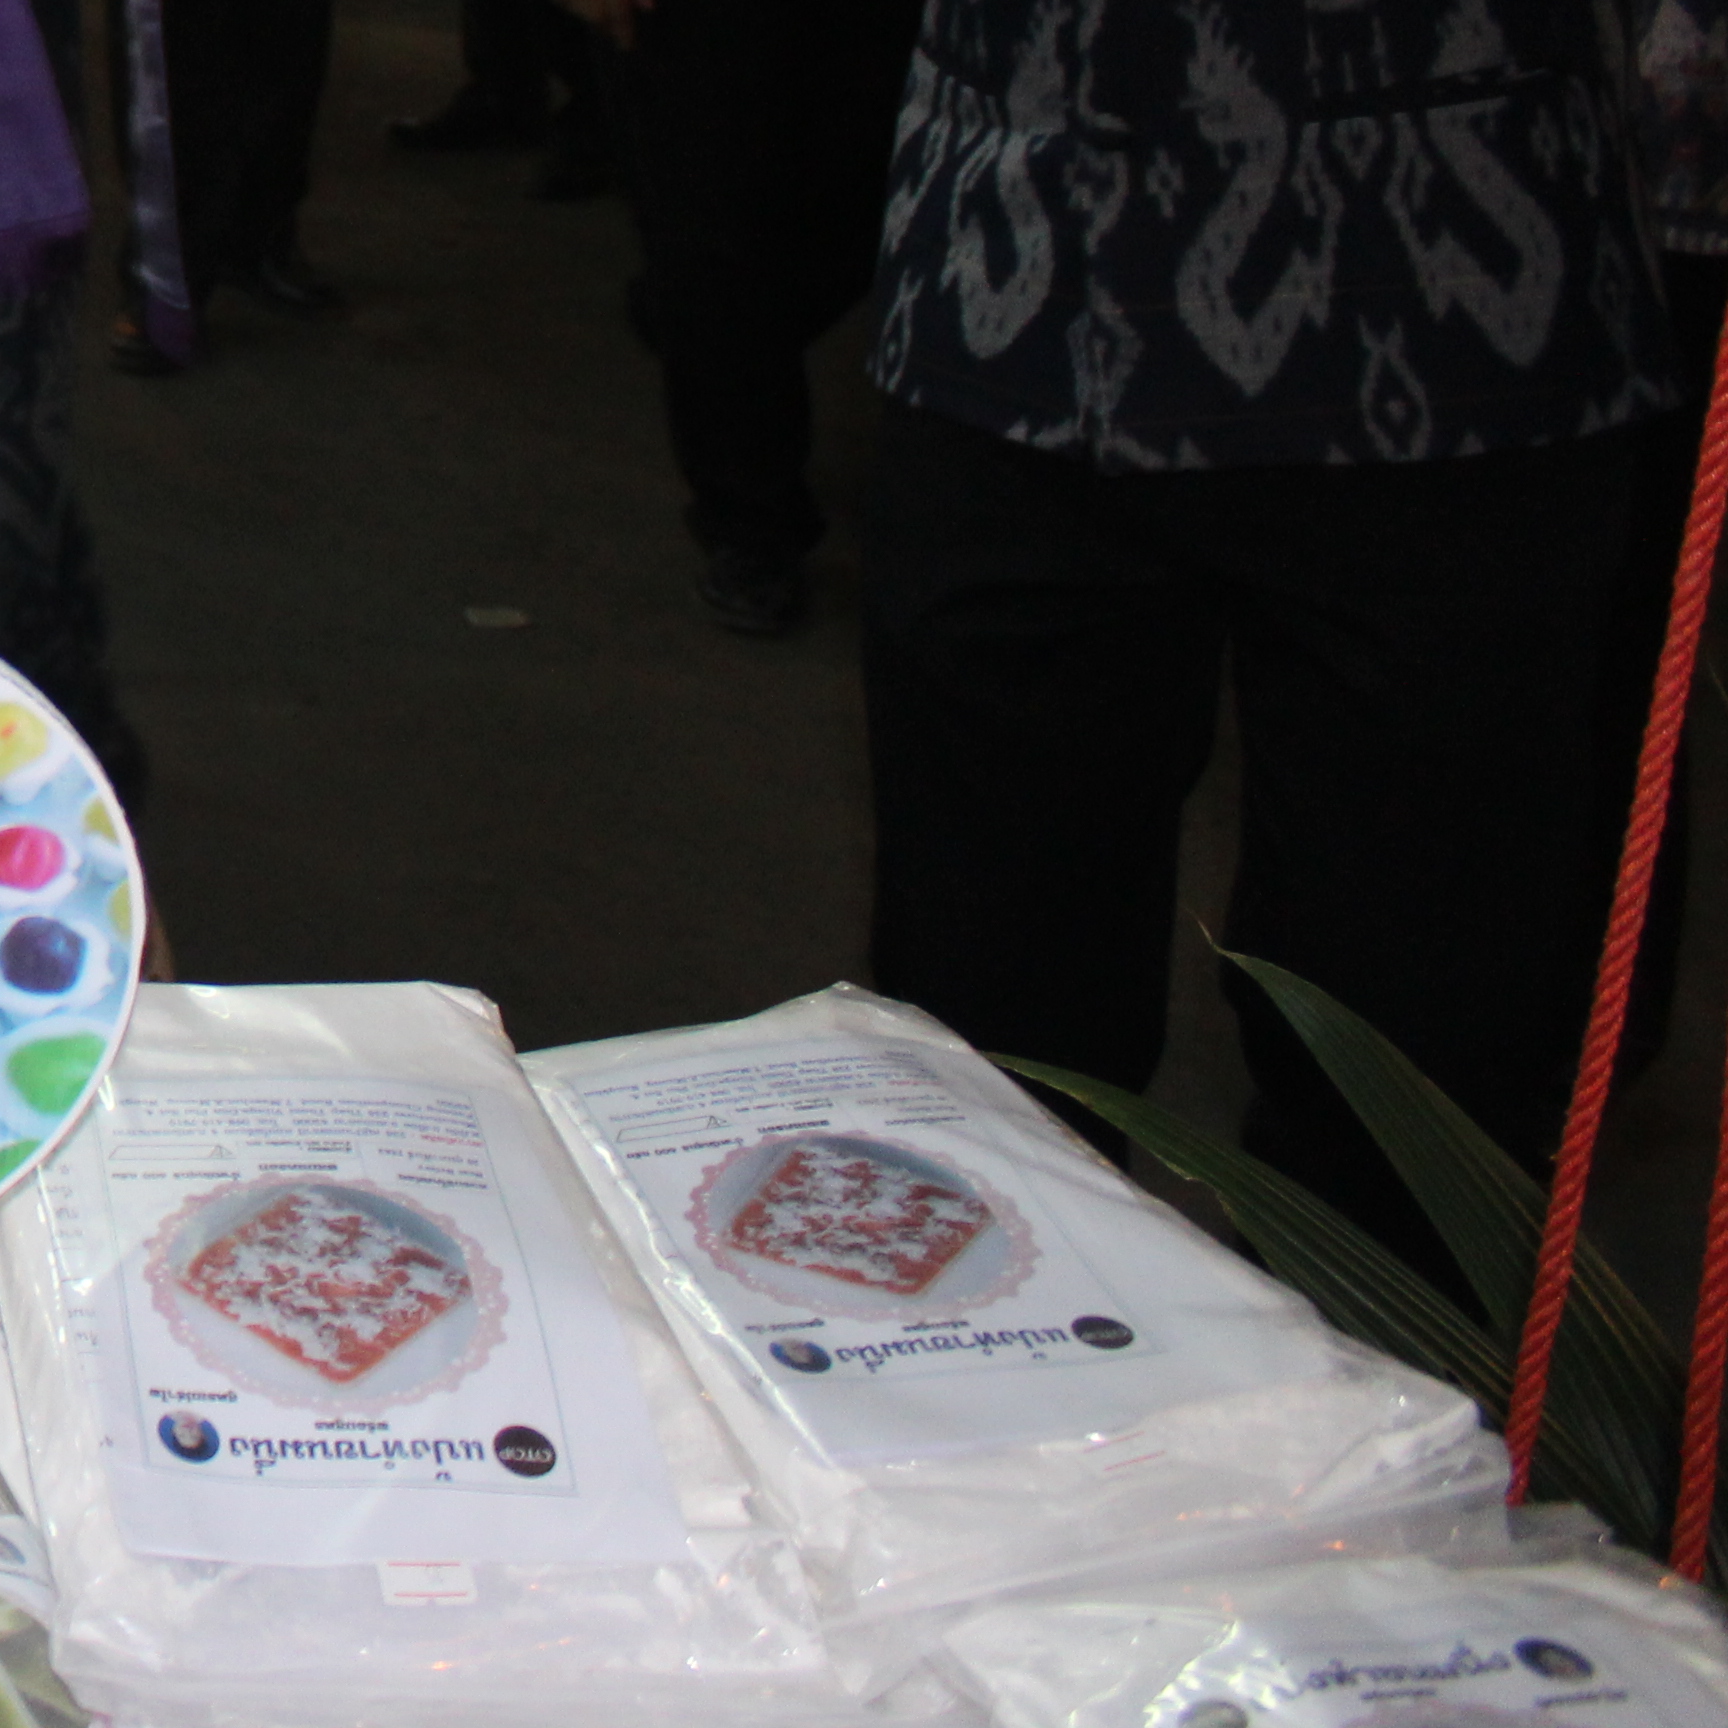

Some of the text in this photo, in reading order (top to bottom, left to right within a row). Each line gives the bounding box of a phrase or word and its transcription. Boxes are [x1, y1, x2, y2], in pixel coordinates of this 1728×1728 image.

[228, 1436, 486, 1482] แป้งทำขนมนึ่ง
